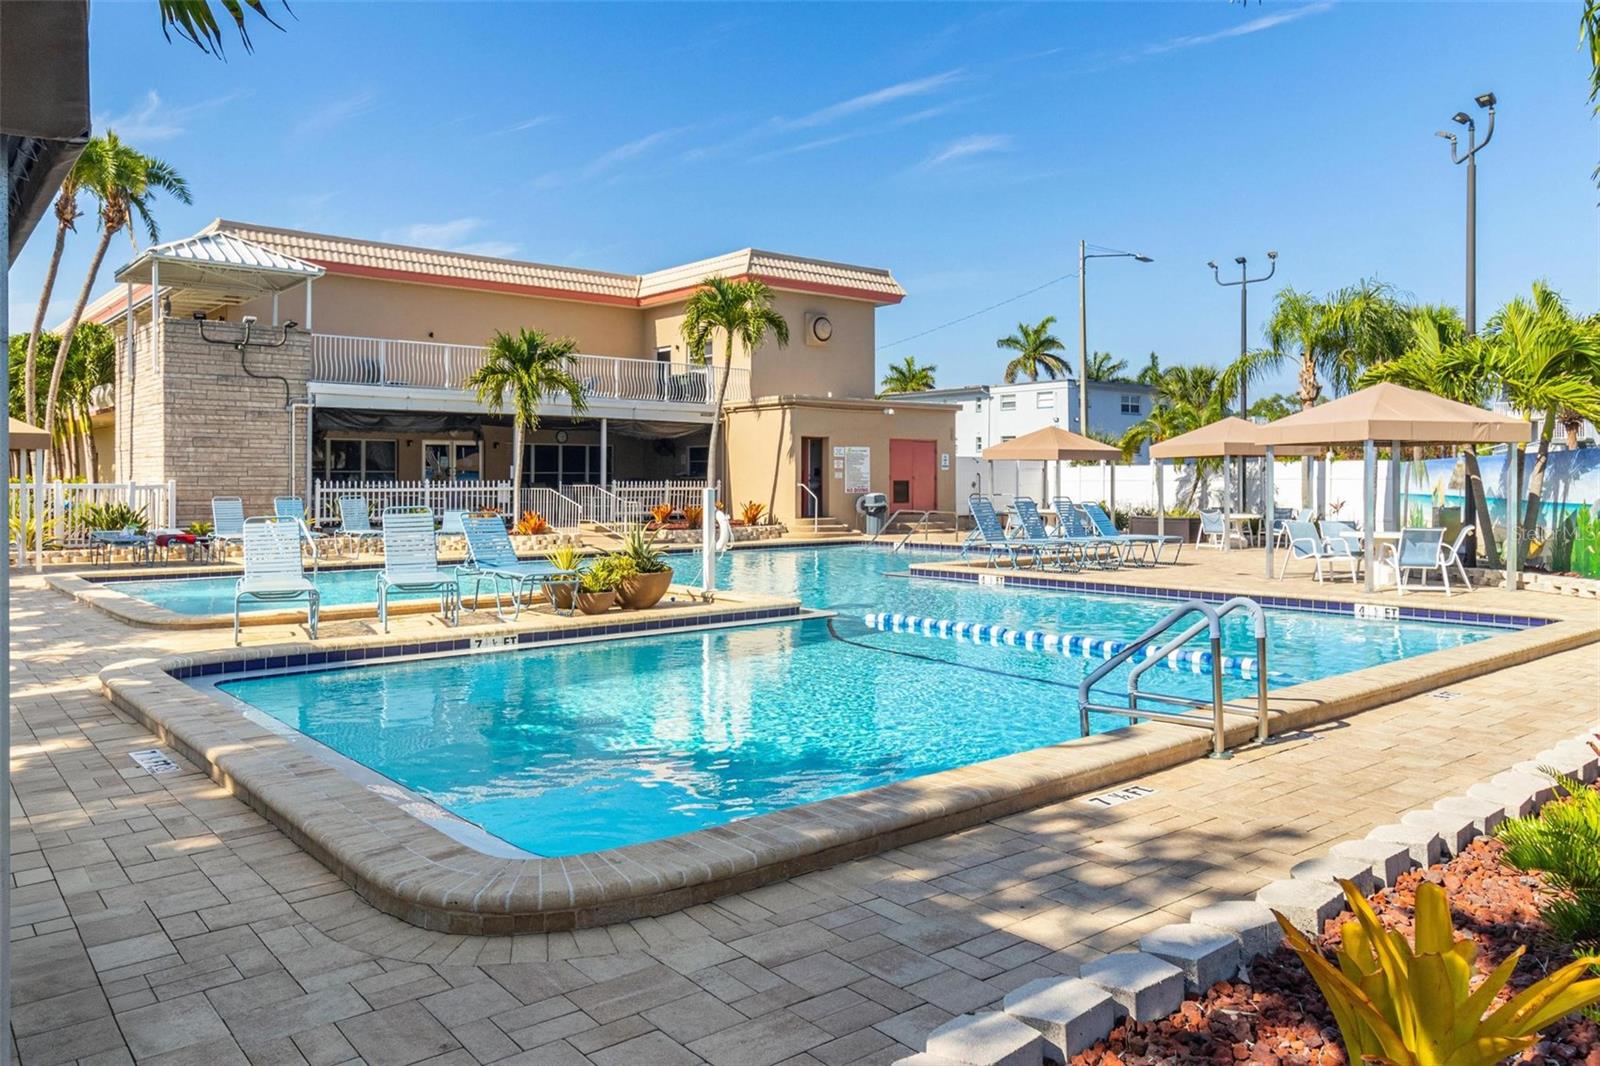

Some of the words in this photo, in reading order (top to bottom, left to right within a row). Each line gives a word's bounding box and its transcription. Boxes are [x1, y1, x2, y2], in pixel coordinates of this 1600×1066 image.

[474, 639, 483, 648] 7
[503, 635, 517, 646] FT
[1088, 797, 1111, 806] 7
[1122, 785, 1155, 797] FT
